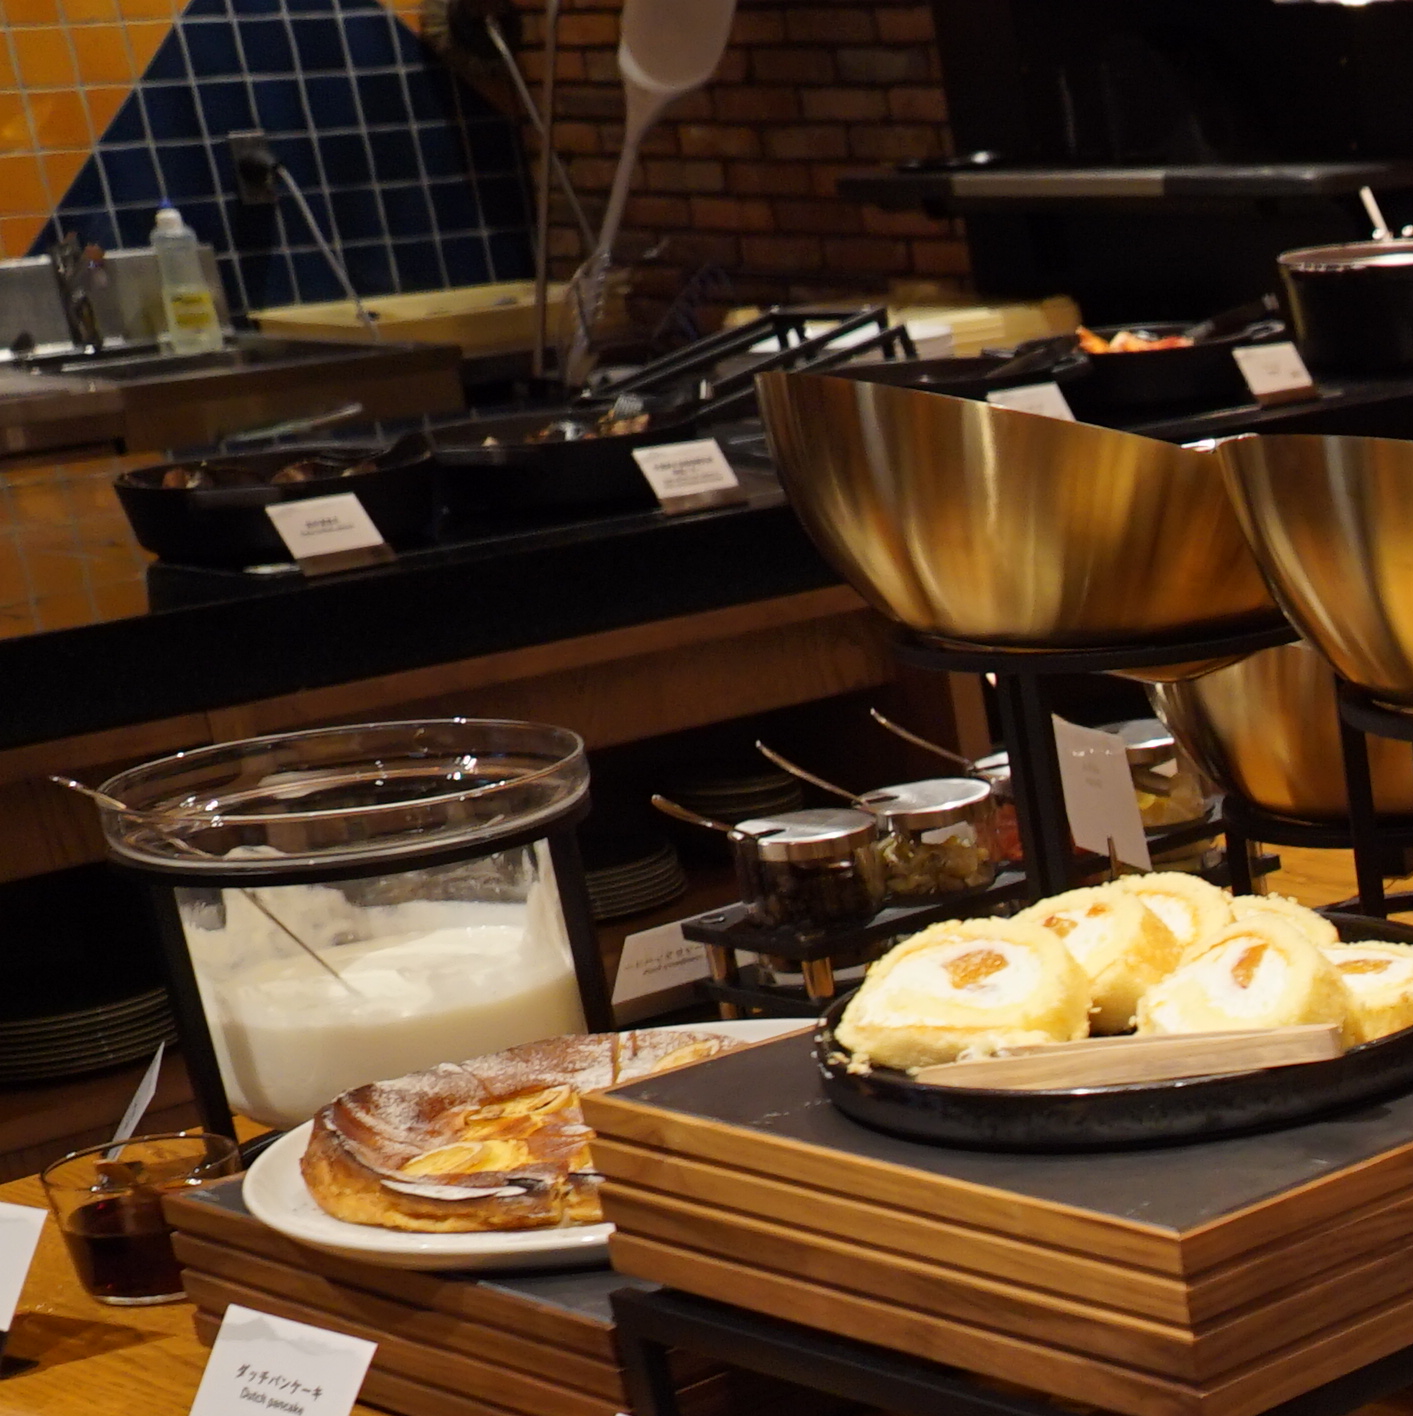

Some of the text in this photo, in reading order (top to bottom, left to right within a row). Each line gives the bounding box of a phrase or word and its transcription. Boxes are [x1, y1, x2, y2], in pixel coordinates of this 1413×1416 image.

[235, 1364, 323, 1401] ダッチパンケーキ
